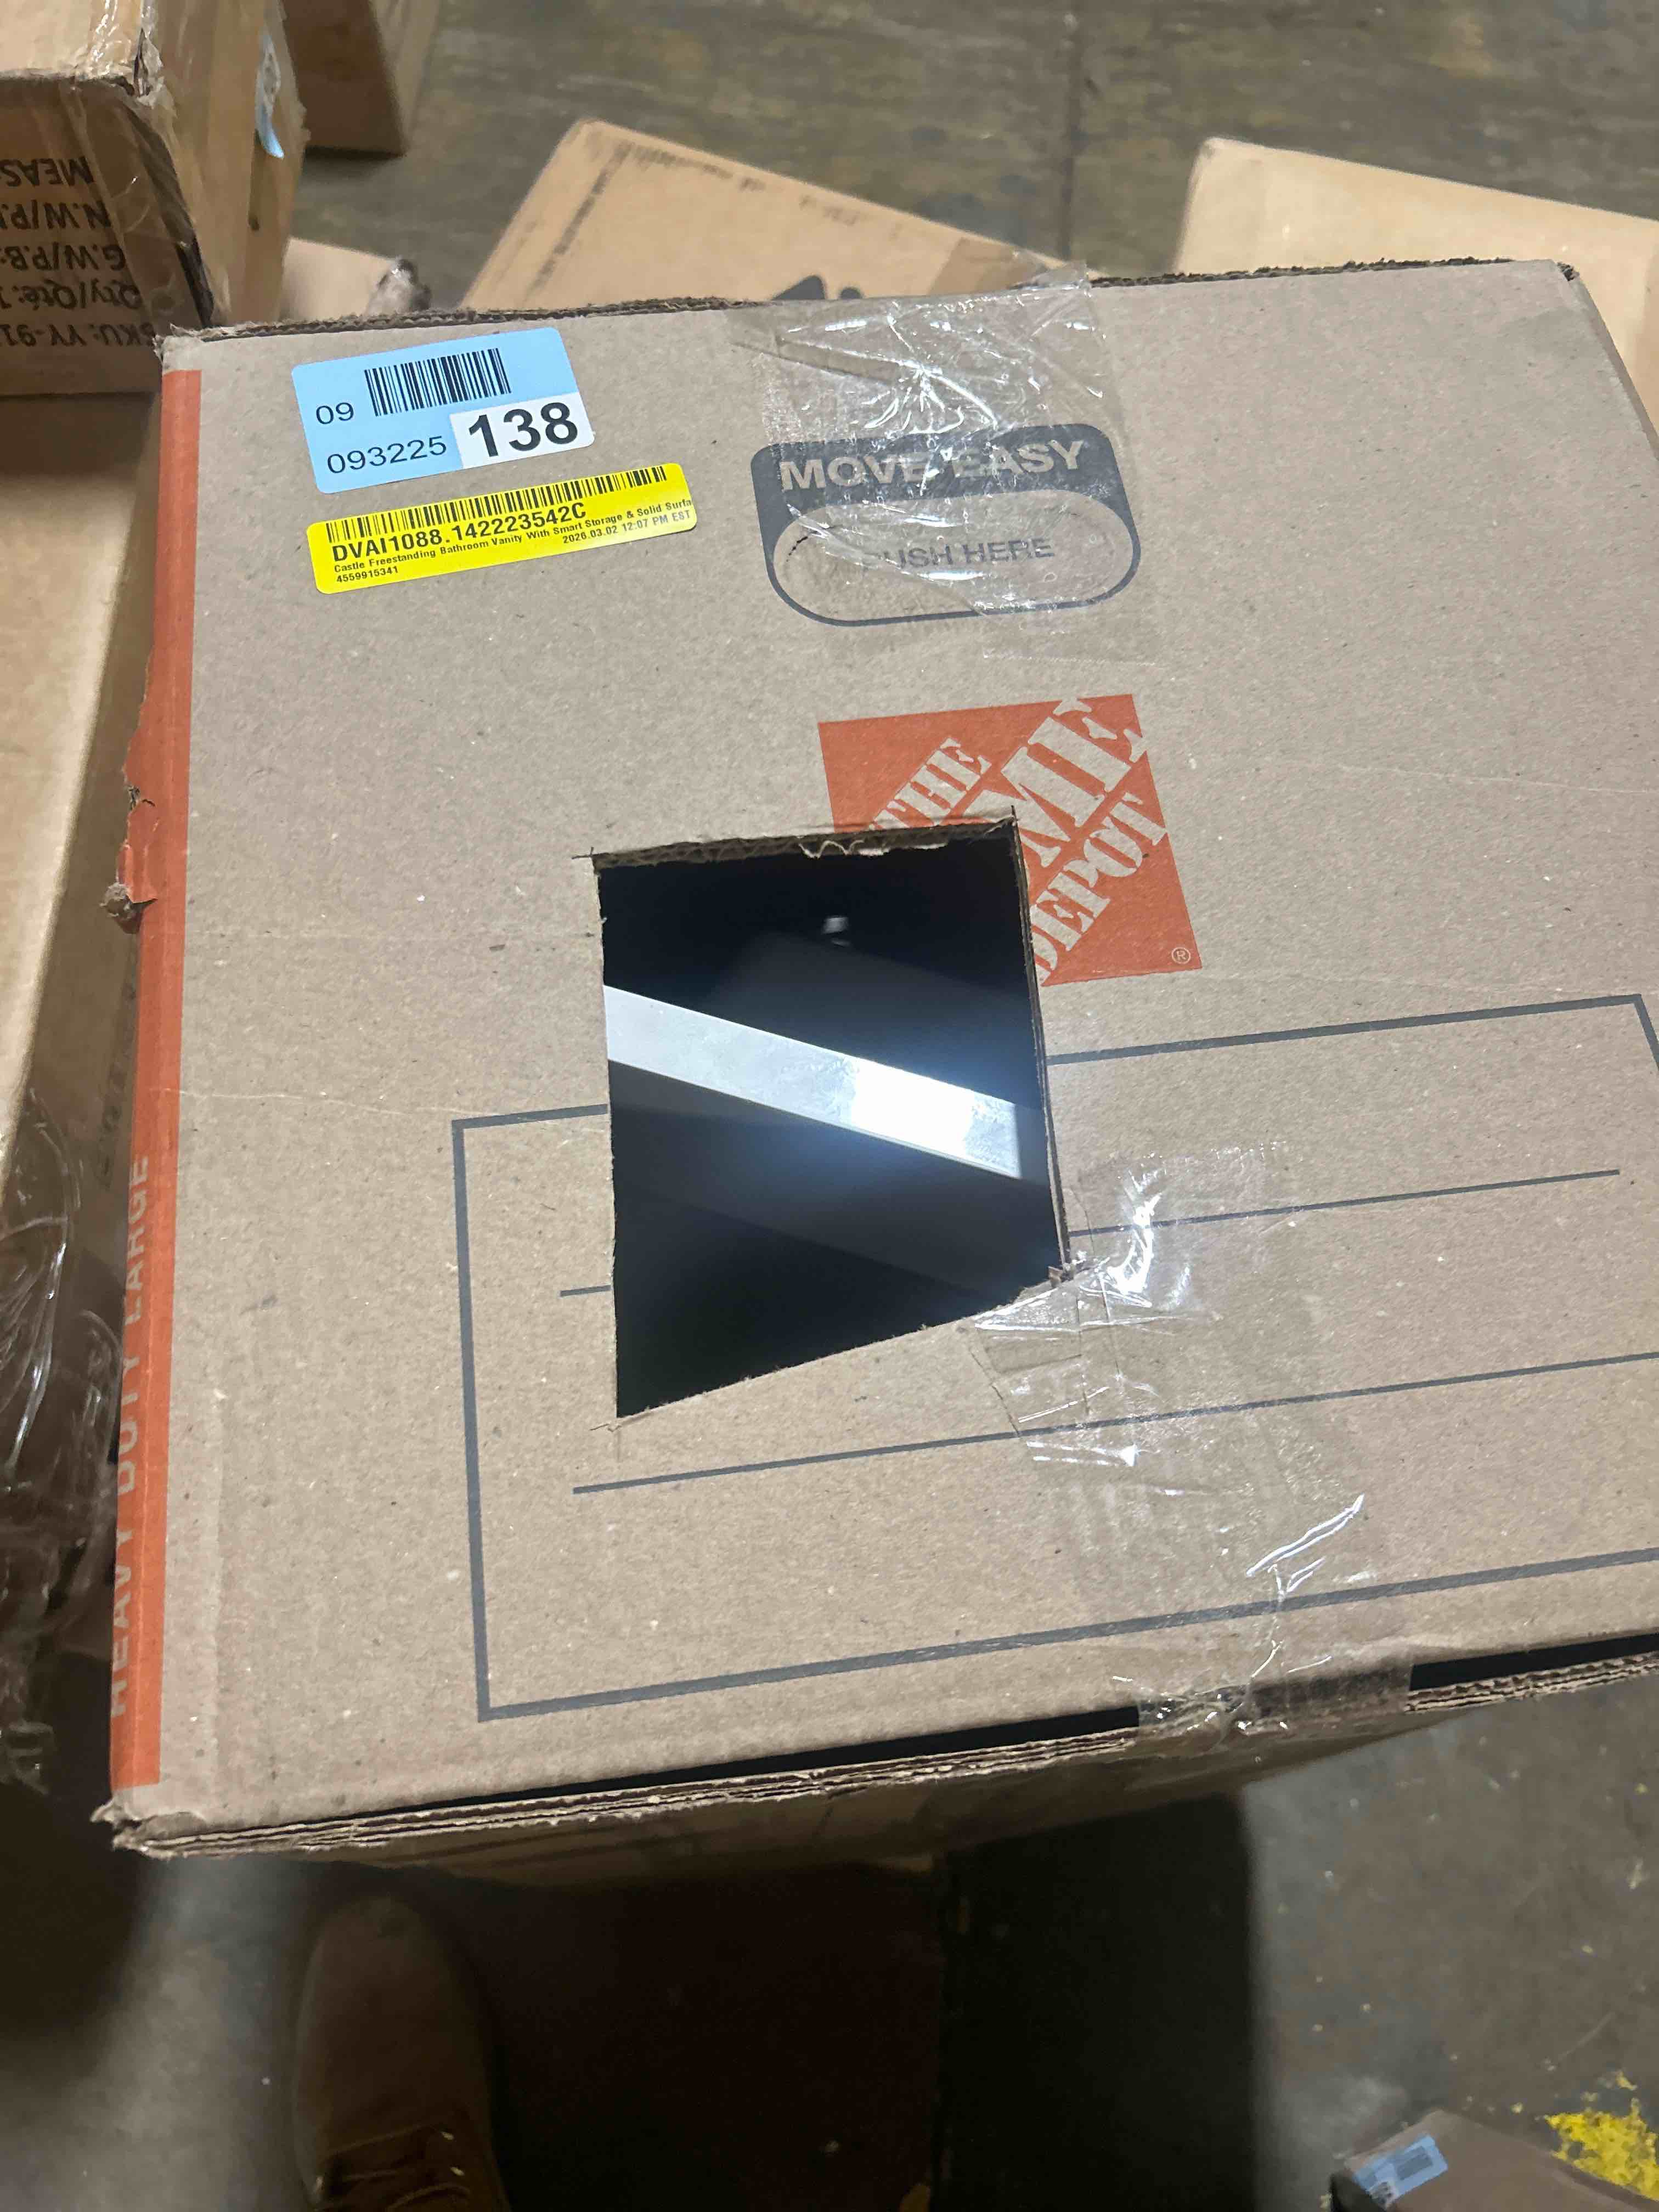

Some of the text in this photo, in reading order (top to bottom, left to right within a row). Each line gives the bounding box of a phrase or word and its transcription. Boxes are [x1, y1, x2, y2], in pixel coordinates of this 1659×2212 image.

[315, 402, 354, 425] 09
[468, 402, 578, 458] 138
[326, 436, 447, 473] 093225
[780, 439, 1084, 493] MOVE EASY
[334, 561, 365, 573] Castle
[369, 550, 436, 567] Freestanding
[440, 540, 489, 555] Bathroom
[492, 534, 522, 545] Vanity
[527, 529, 550, 539] With
[554, 522, 582, 535] Smart
[585, 514, 623, 528] Storage
[626, 510, 635, 518] &
[637, 505, 662, 517] Solid
[563, 510, 691, 544] 2026.03.02 12:07 PM EST
[863, 538, 1055, 569] USH HERE
[336, 566, 399, 583] 4559915341
